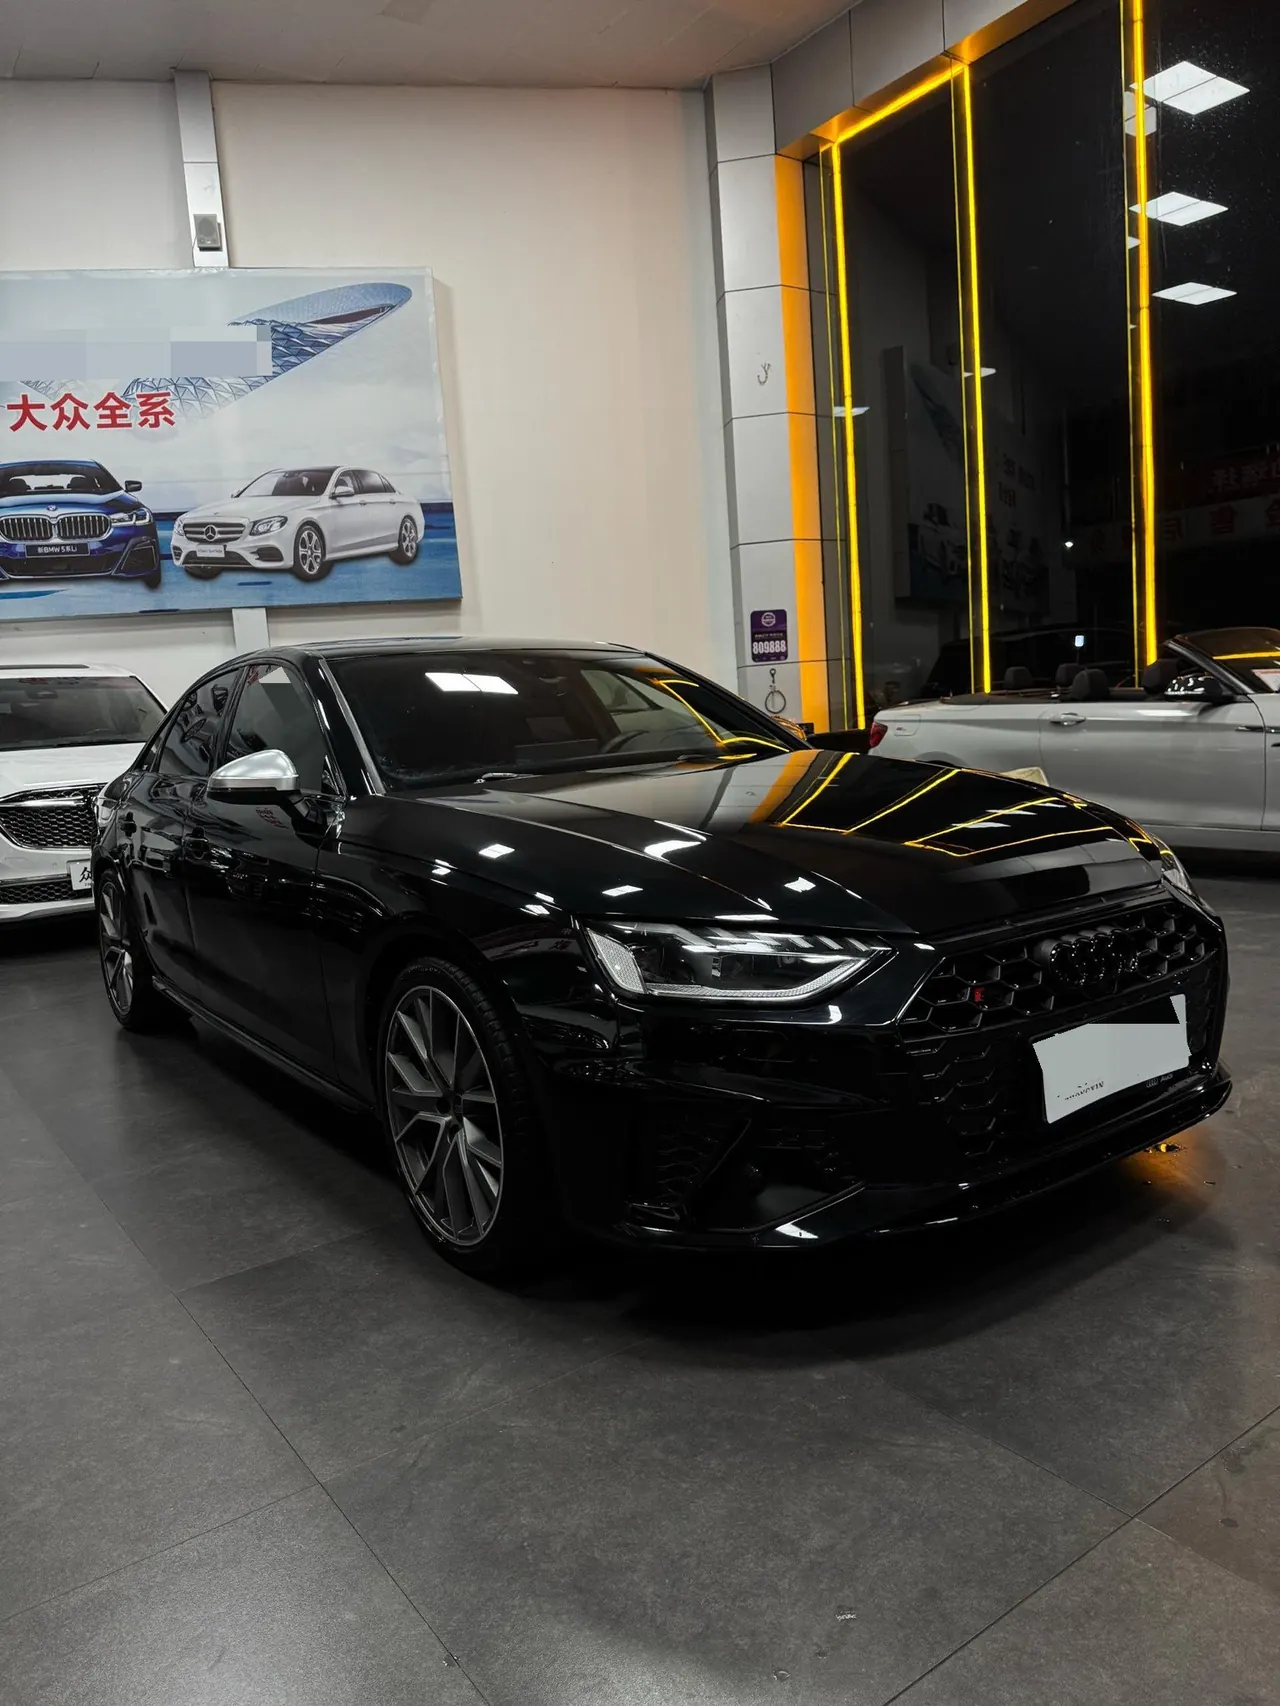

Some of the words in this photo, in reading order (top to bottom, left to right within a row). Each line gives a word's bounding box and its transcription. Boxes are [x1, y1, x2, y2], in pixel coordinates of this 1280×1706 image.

[6, 391, 176, 432] 大众全系
[752, 640, 787, 655] 809888
